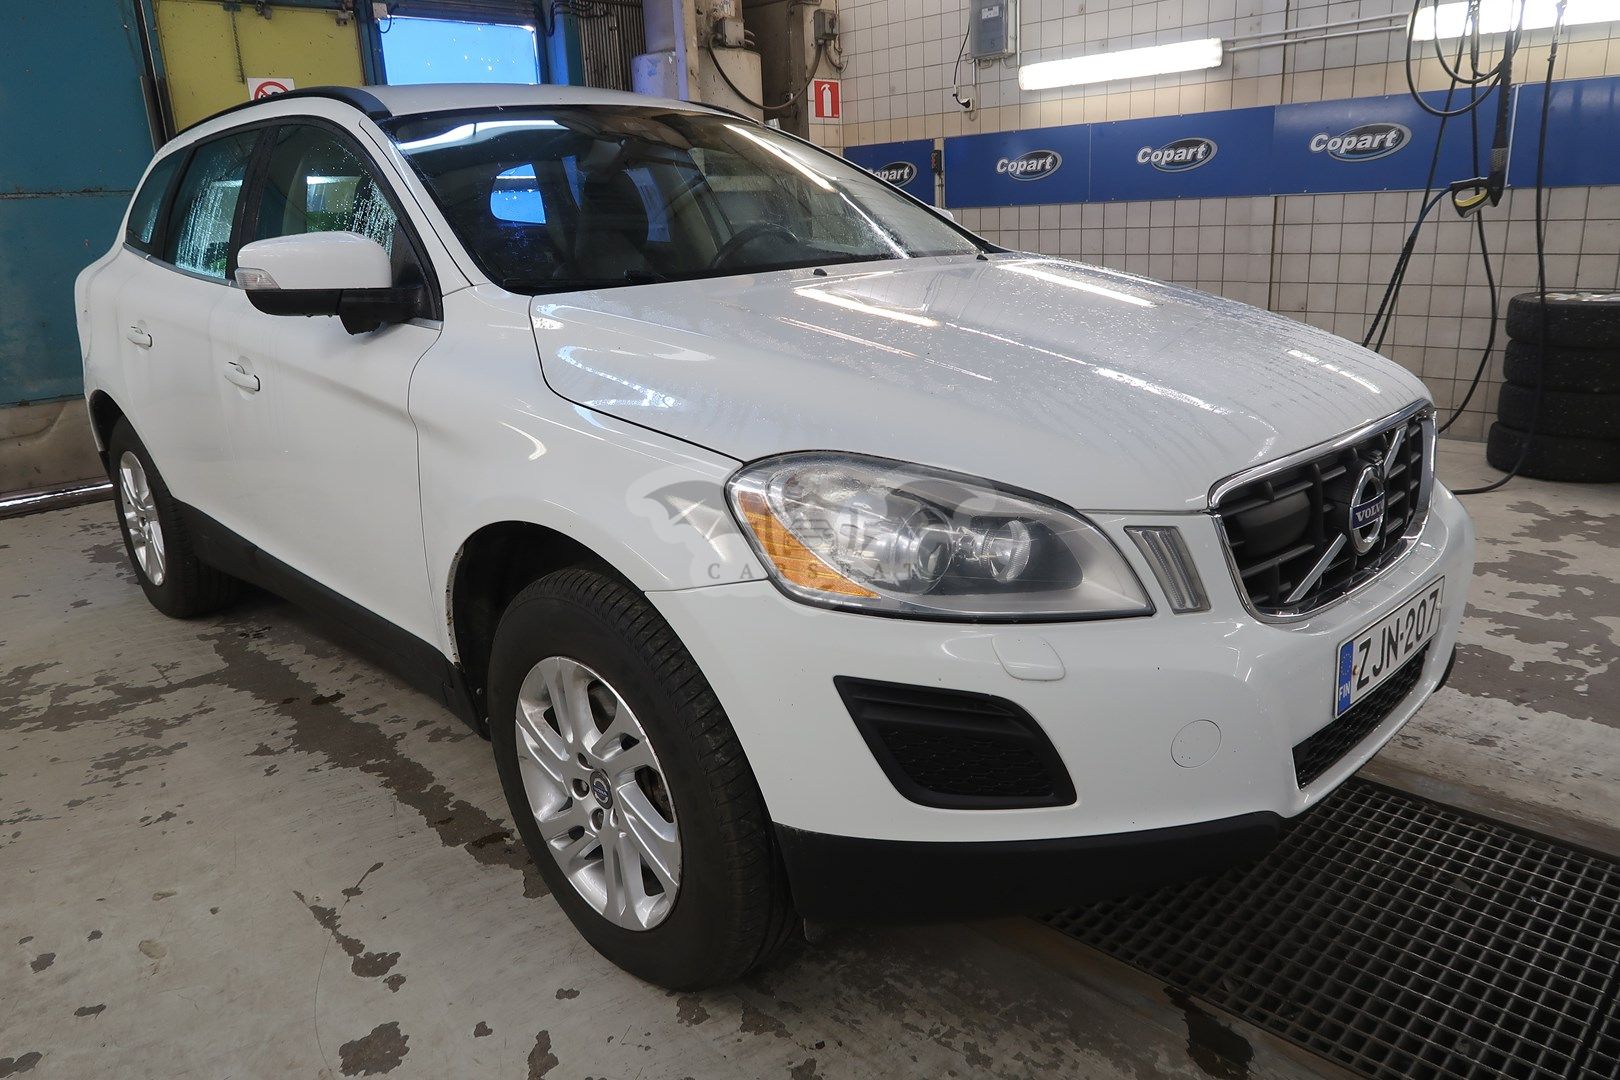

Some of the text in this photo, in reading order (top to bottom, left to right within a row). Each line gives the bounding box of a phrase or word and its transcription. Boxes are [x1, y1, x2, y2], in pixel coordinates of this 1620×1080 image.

[1310, 129, 1397, 154] Copart
[996, 155, 1053, 175] Copart
[1137, 144, 1206, 165] Copart
[1356, 588, 1440, 691] ZJN-207
[1339, 681, 1351, 702] FIN
